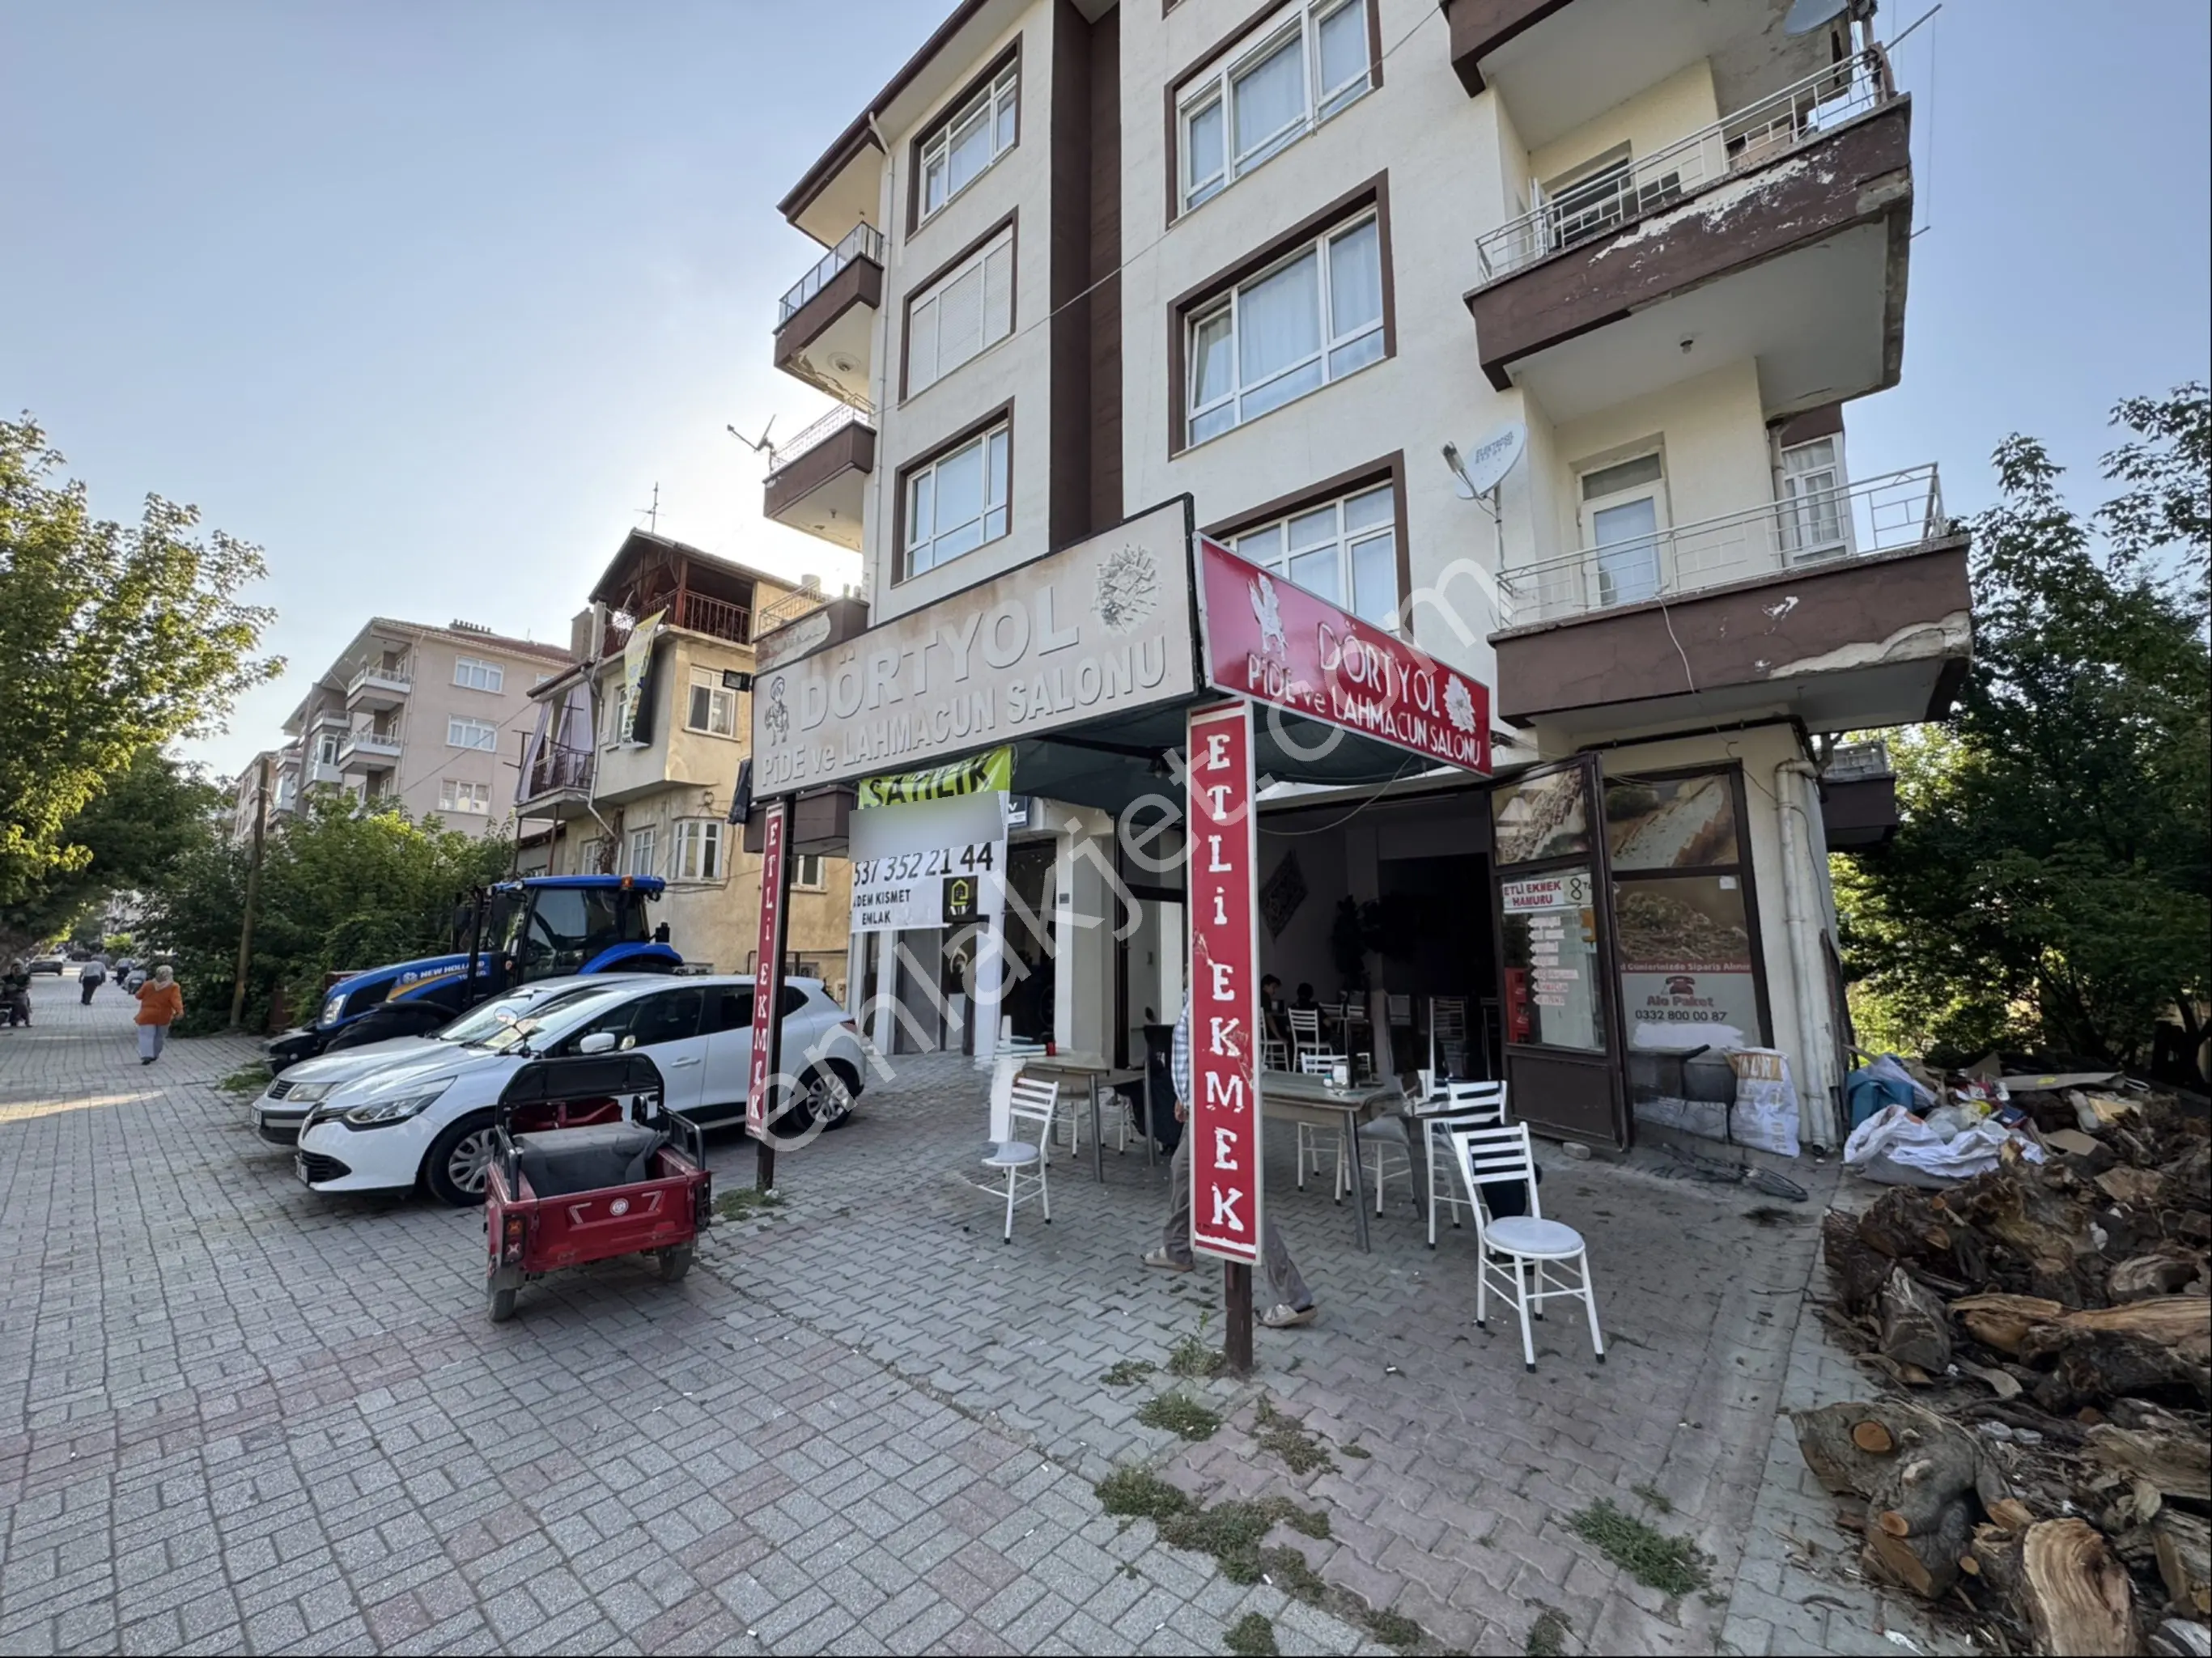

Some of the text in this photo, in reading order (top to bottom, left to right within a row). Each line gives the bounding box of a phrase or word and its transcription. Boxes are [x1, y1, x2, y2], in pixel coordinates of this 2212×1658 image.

[800, 586, 1078, 731] DÖRTYOL
[1318, 621, 1440, 718] DÖRTYOL
[811, 748, 835, 774] ve
[843, 685, 996, 766] LAHMACUN
[1008, 635, 1165, 723] SALONU
[1301, 689, 1327, 713] ve
[1332, 687, 1428, 746] LAHMACUN
[1430, 726, 1480, 766] SALONU
[884, 852, 922, 881] 352
[924, 848, 952, 876] 21
[960, 842, 993, 872] 44
[876, 888, 911, 905] KISMET
[1526, 880, 1561, 893] EKMEK
[1570, 877, 1582, 901] 8
[1513, 894, 1553, 906] HAMURU
[862, 910, 891, 926] EMLAK
[420, 967, 443, 978] NEW
[1646, 995, 1715, 1007] Alo Paket
[1635, 1010, 1728, 1021] 0332 800 00 87
[749, 963, 768, 1120] EKMEK
[1204, 964, 1245, 1232] EKMEK
